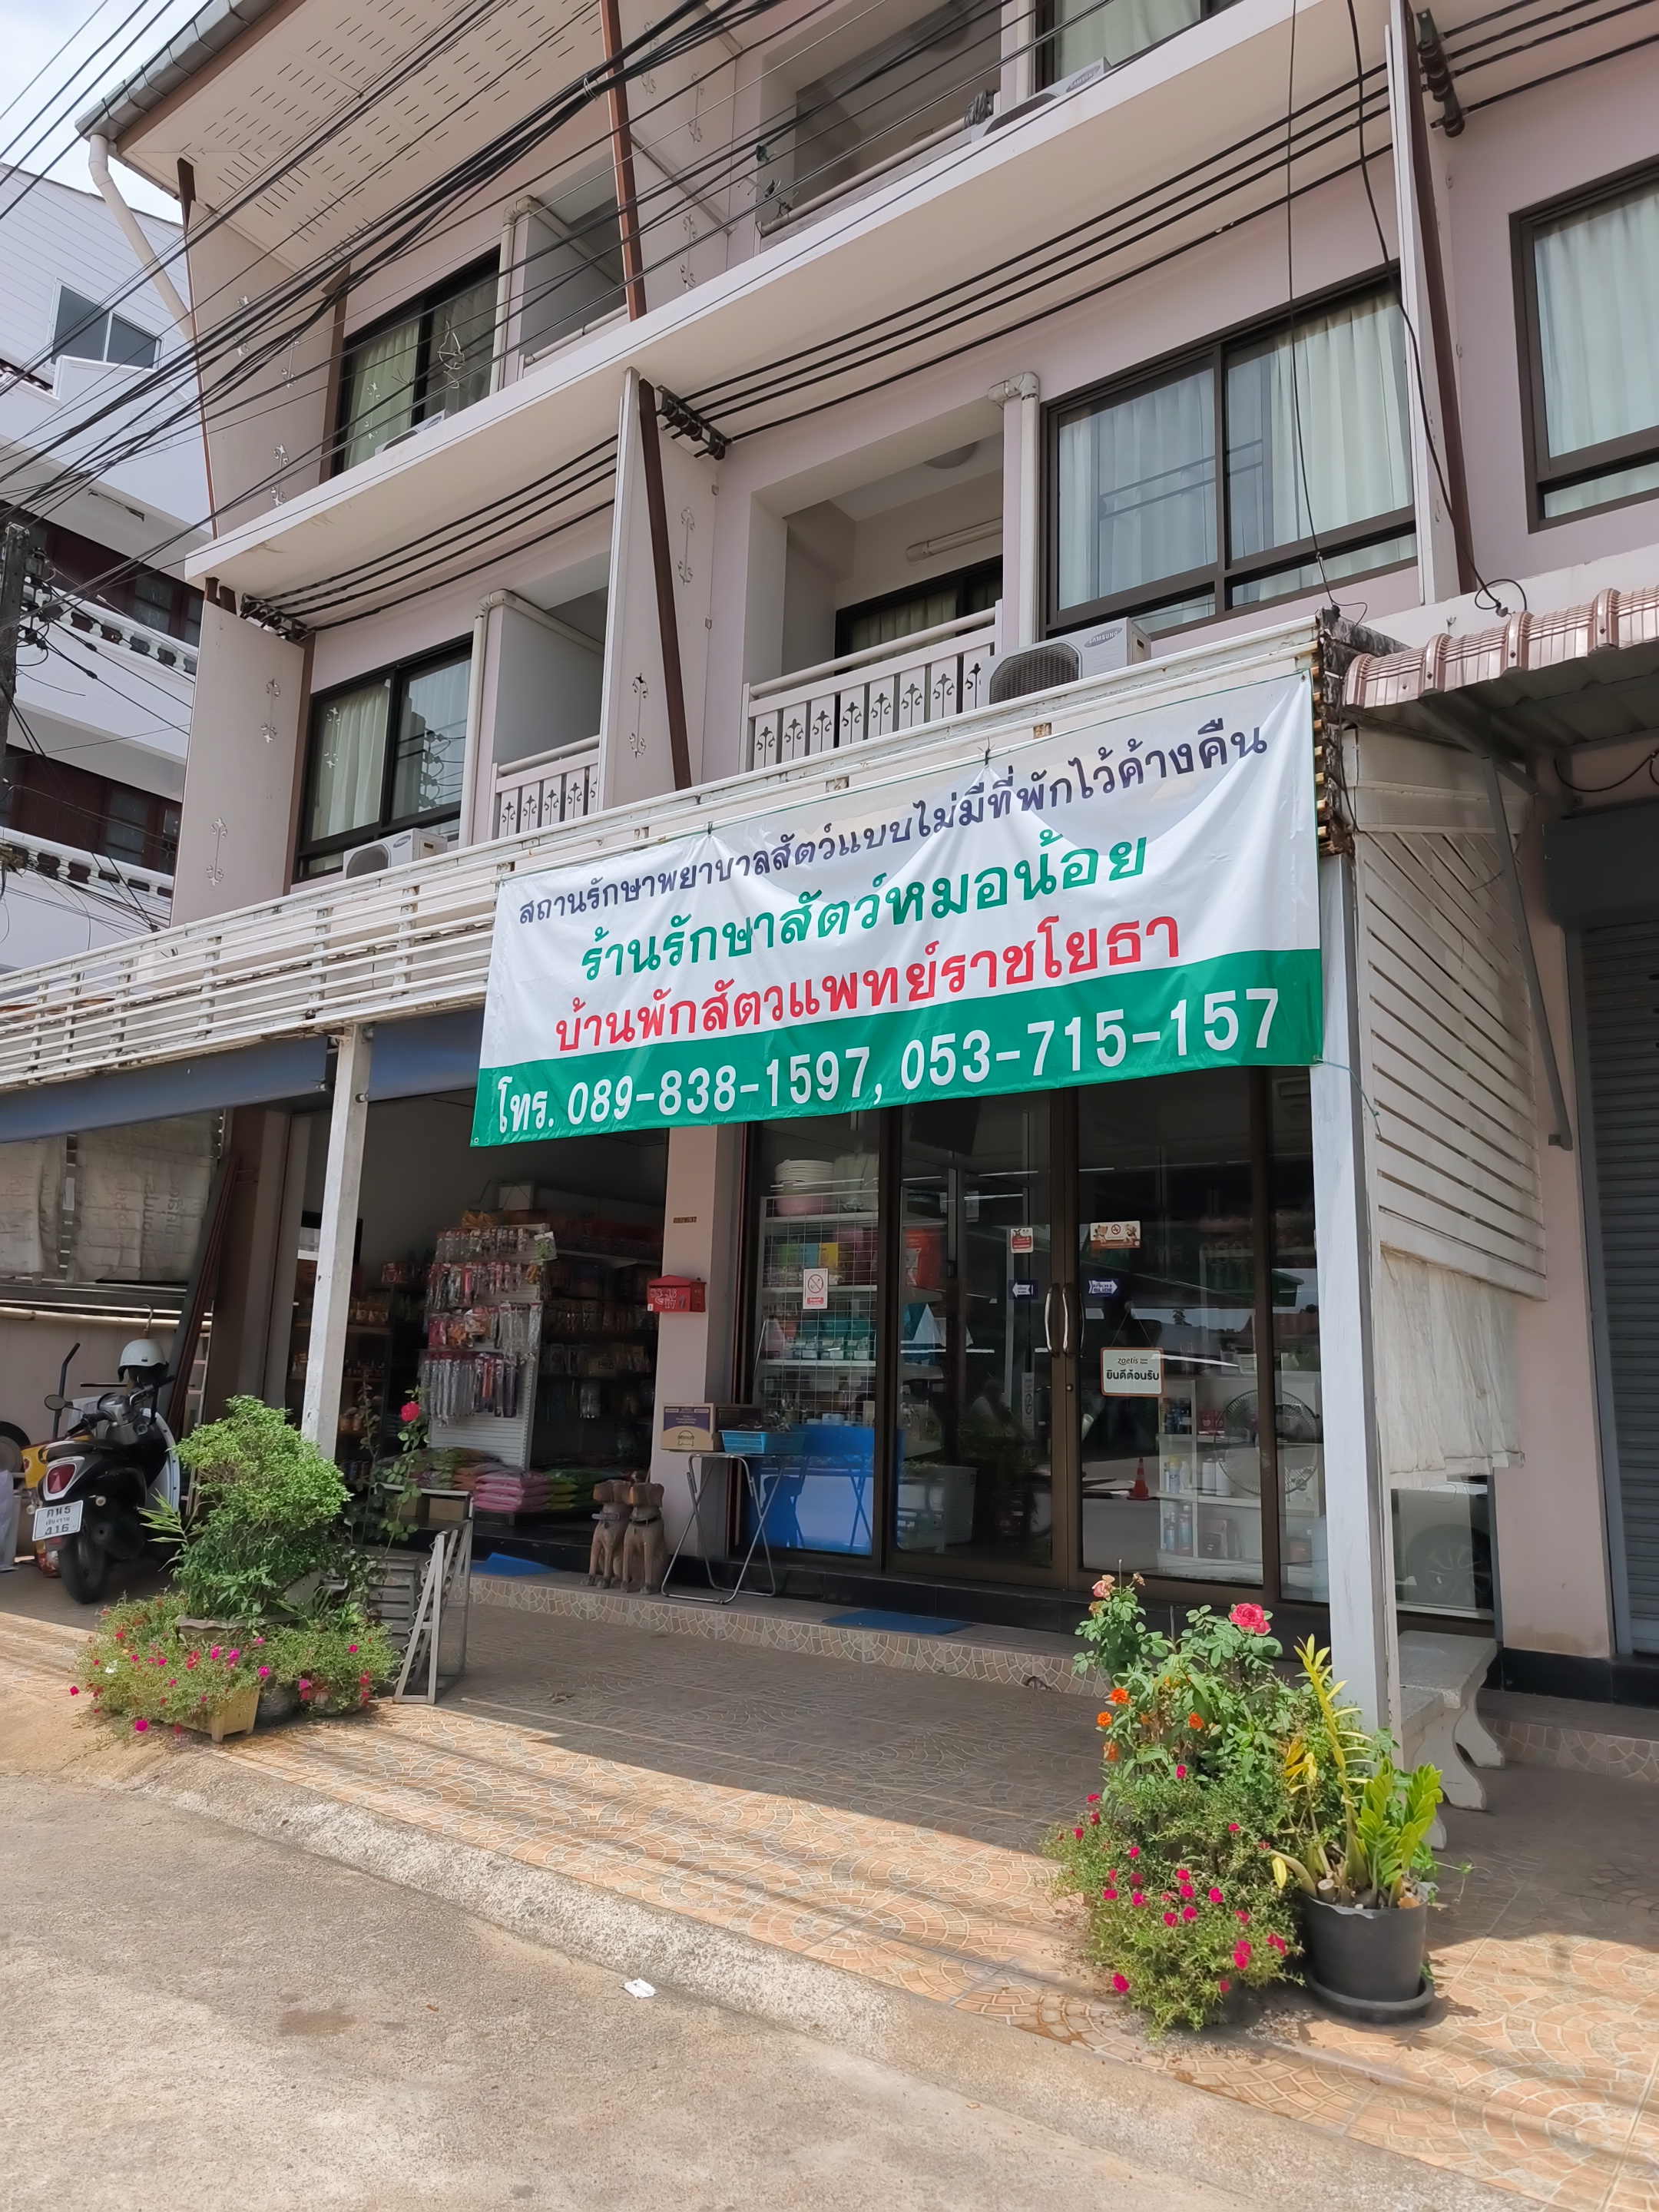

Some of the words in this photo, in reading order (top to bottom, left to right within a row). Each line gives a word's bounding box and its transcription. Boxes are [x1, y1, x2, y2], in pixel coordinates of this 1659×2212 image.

[1088, 630, 1119, 644] SAMSUNG
[518, 717, 1268, 924] สถานรักษาพยาบาลสัตว์แบบไม่มีที่พักไว้ค้างคืน
[581, 829, 1147, 981] ร้านรักษาสัตว์หมอน้อย
[555, 915, 1180, 1052] บ้านพักสัตวแพทย์ราชโยธา
[497, 1076, 554, 1134] โทร.
[567, 1046, 883, 1124] 089-838-1597,
[900, 988, 1280, 1091] 053-715-157
[1106, 1369, 1160, 1381] ยินดีต้อนรับ
[1118, 1356, 1138, 1366] zoetis
